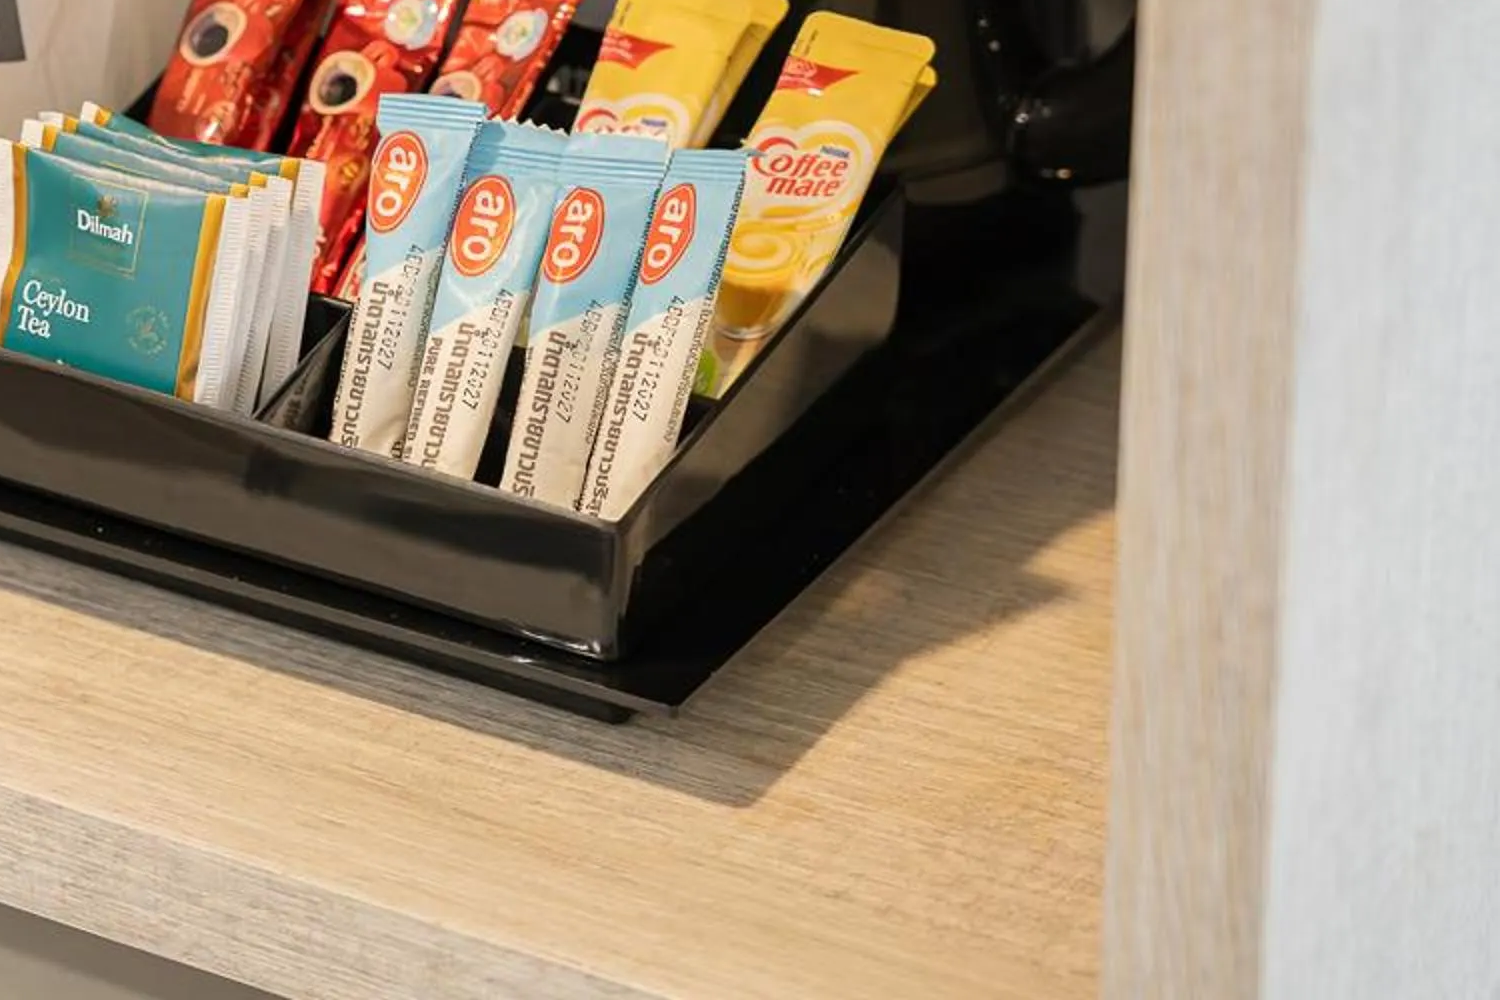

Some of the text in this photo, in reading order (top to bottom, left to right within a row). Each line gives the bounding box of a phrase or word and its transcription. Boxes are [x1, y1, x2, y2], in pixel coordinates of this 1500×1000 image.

[751, 137, 849, 178] Coffee
[375, 147, 418, 217] aro
[766, 177, 841, 197] mate
[76, 209, 134, 246] Dilmah
[462, 190, 505, 261] aro
[551, 199, 594, 269] aro
[647, 199, 688, 269] aro
[17, 305, 51, 339] Tea
[21, 279, 91, 324] Ceylon
[421, 336, 444, 377] PURE
